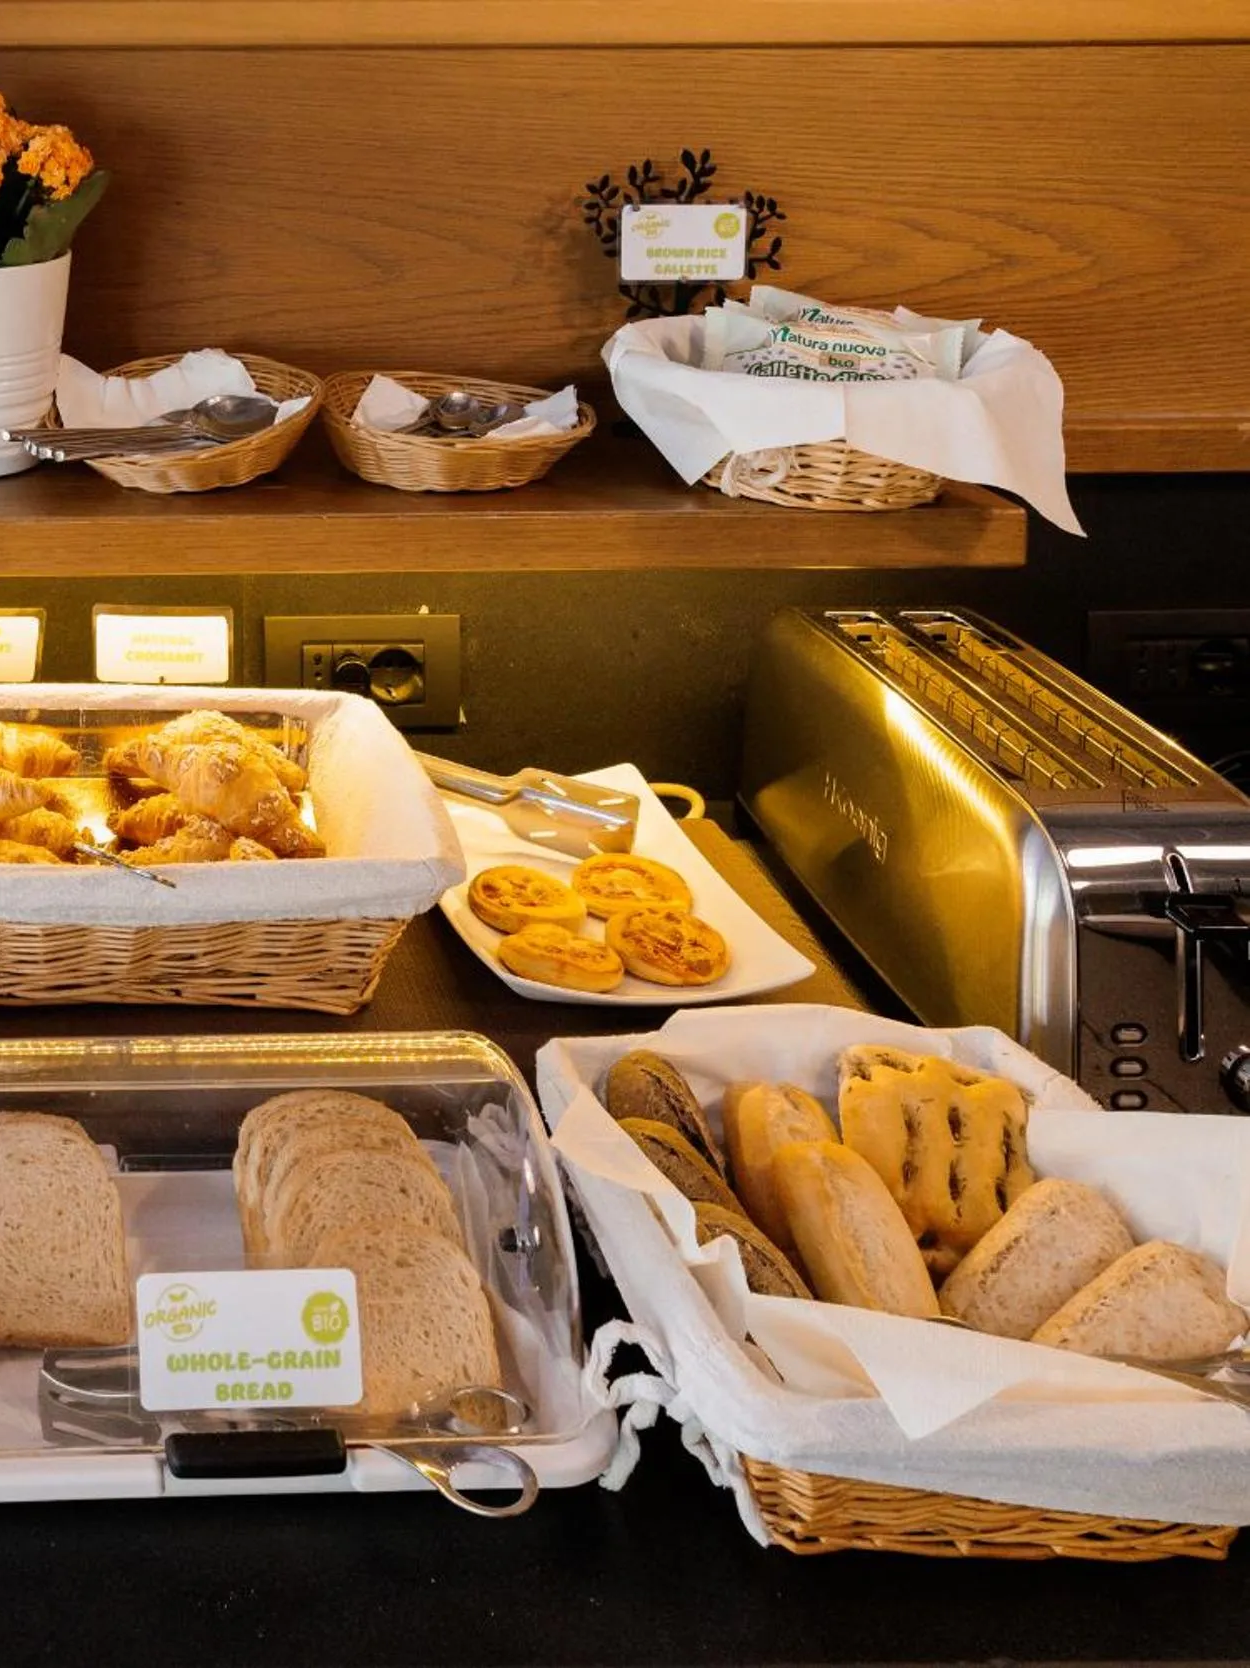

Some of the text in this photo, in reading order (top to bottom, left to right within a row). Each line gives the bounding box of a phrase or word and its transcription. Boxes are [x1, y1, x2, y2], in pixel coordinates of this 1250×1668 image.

[696, 247, 727, 259] RICE
[831, 341, 887, 357] nuova
[144, 1300, 218, 1329] ORGANIC
[311, 1313, 343, 1333] BIO
[166, 1349, 342, 1373] WHOLE-GRAIN
[214, 1381, 294, 1402] BREAD
